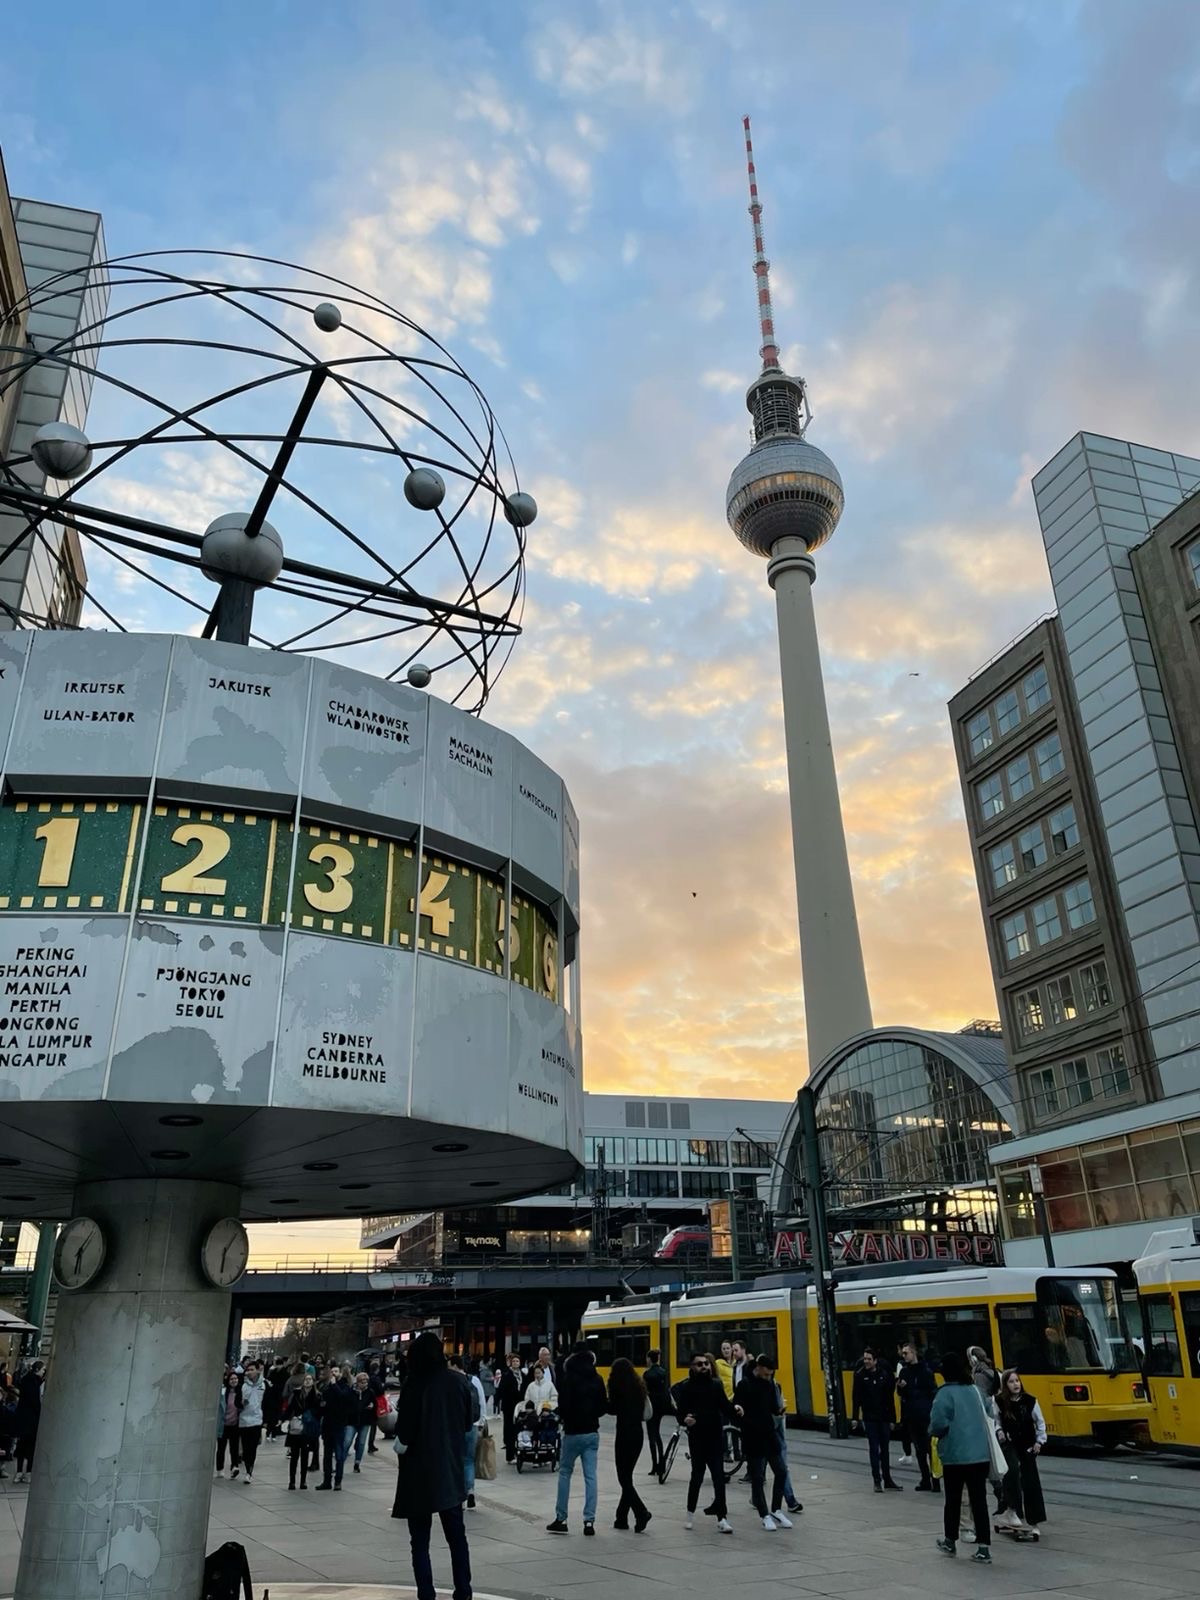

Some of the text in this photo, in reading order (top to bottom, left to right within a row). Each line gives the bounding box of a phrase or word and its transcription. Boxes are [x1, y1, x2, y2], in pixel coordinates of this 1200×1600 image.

[64, 682, 126, 694] IRKUTSK
[208, 678, 272, 697] JAKUTSK
[43, 710, 136, 723] ULAN-BATOR
[328, 700, 409, 731] CHABAROWSK
[326, 712, 410, 744] WLADIWOSTOK
[449, 737, 493, 764] MAGADAN
[449, 750, 493, 777] SACHALIN
[34, 817, 80, 888] 1
[160, 823, 232, 896] 2
[303, 843, 355, 913] 3
[409, 870, 455, 937] 4
[15, 948, 75, 961] PEKING
[0, 965, 87, 978] SHANGHAI
[156, 967, 252, 987] PJÖNGJANG
[4, 982, 72, 995] MANILA
[179, 986, 226, 1002] TOKYO
[10, 1000, 61, 1013] PERTH
[175, 1004, 225, 1019] SEOUL
[27, 1035, 93, 1049] LUMPUR
[322, 1032, 373, 1049] SYDNEY
[307, 1047, 385, 1067] CANBERRA
[302, 1063, 387, 1084] MELBOURNE
[518, 1083, 559, 1107] WELLINGTON
[773, 1231, 999, 1263] ALXANDERP
